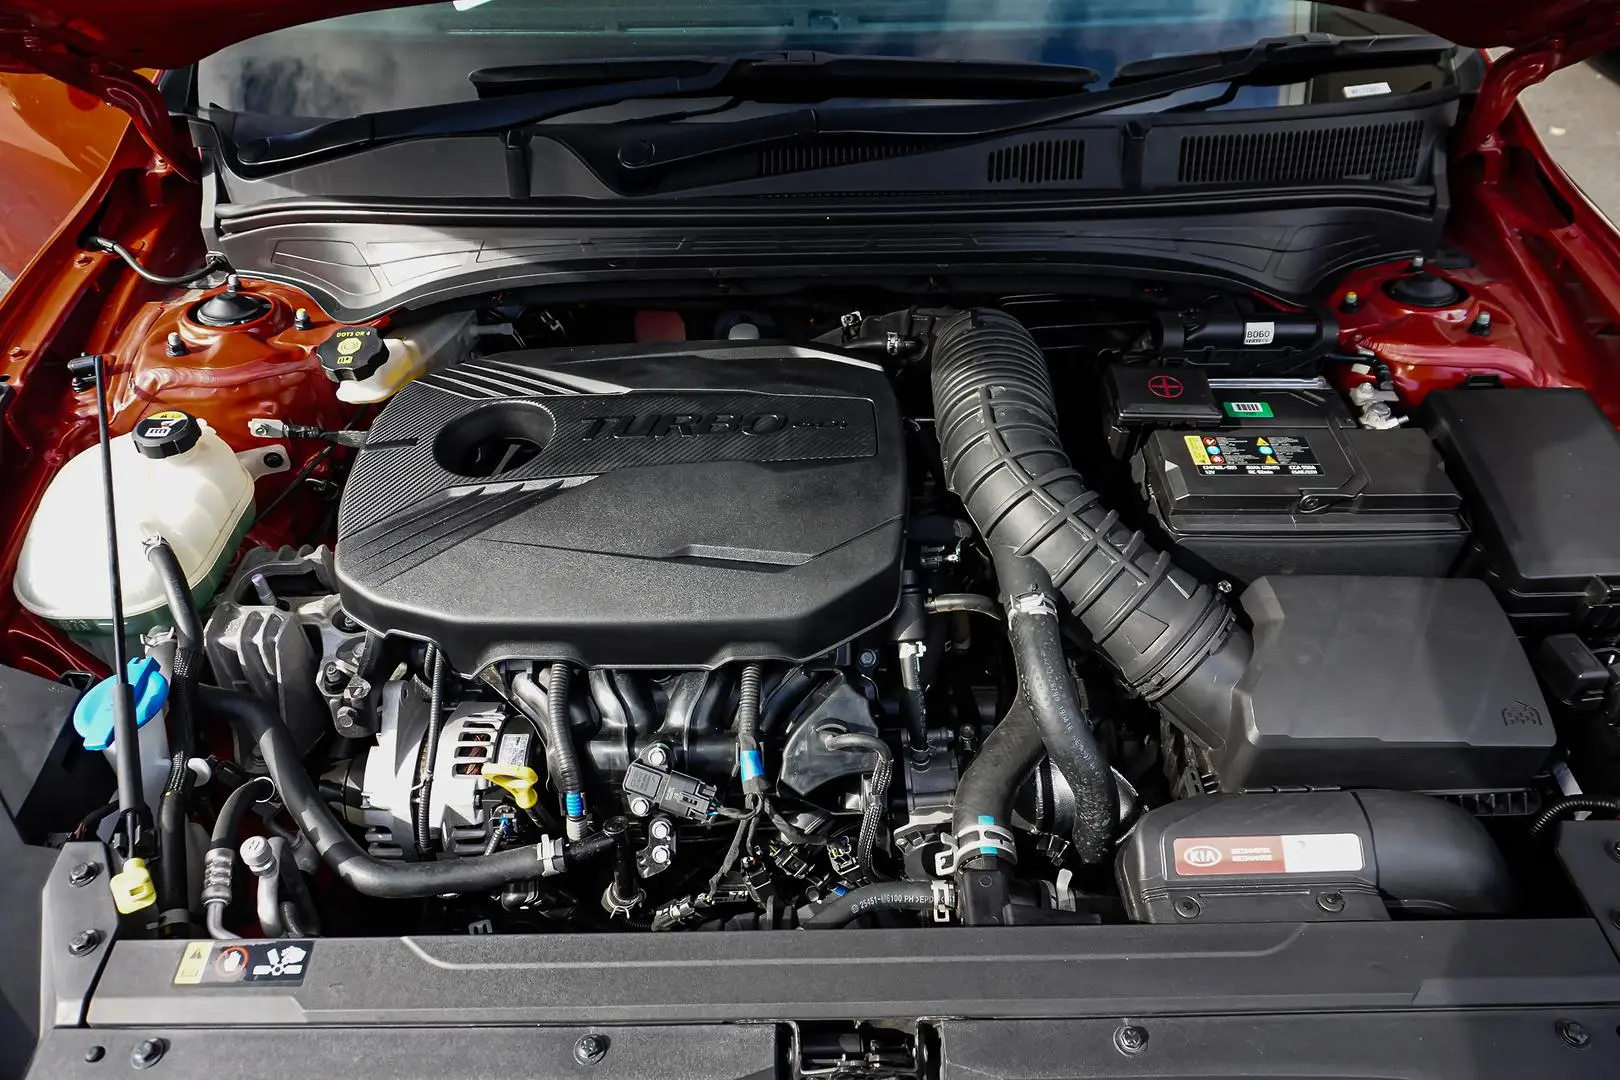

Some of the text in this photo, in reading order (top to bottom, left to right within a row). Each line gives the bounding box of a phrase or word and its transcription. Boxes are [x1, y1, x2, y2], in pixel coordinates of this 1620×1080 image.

[581, 413, 788, 440] TURBO
[1189, 848, 1217, 862] KIA
[904, 895, 914, 903] PH
